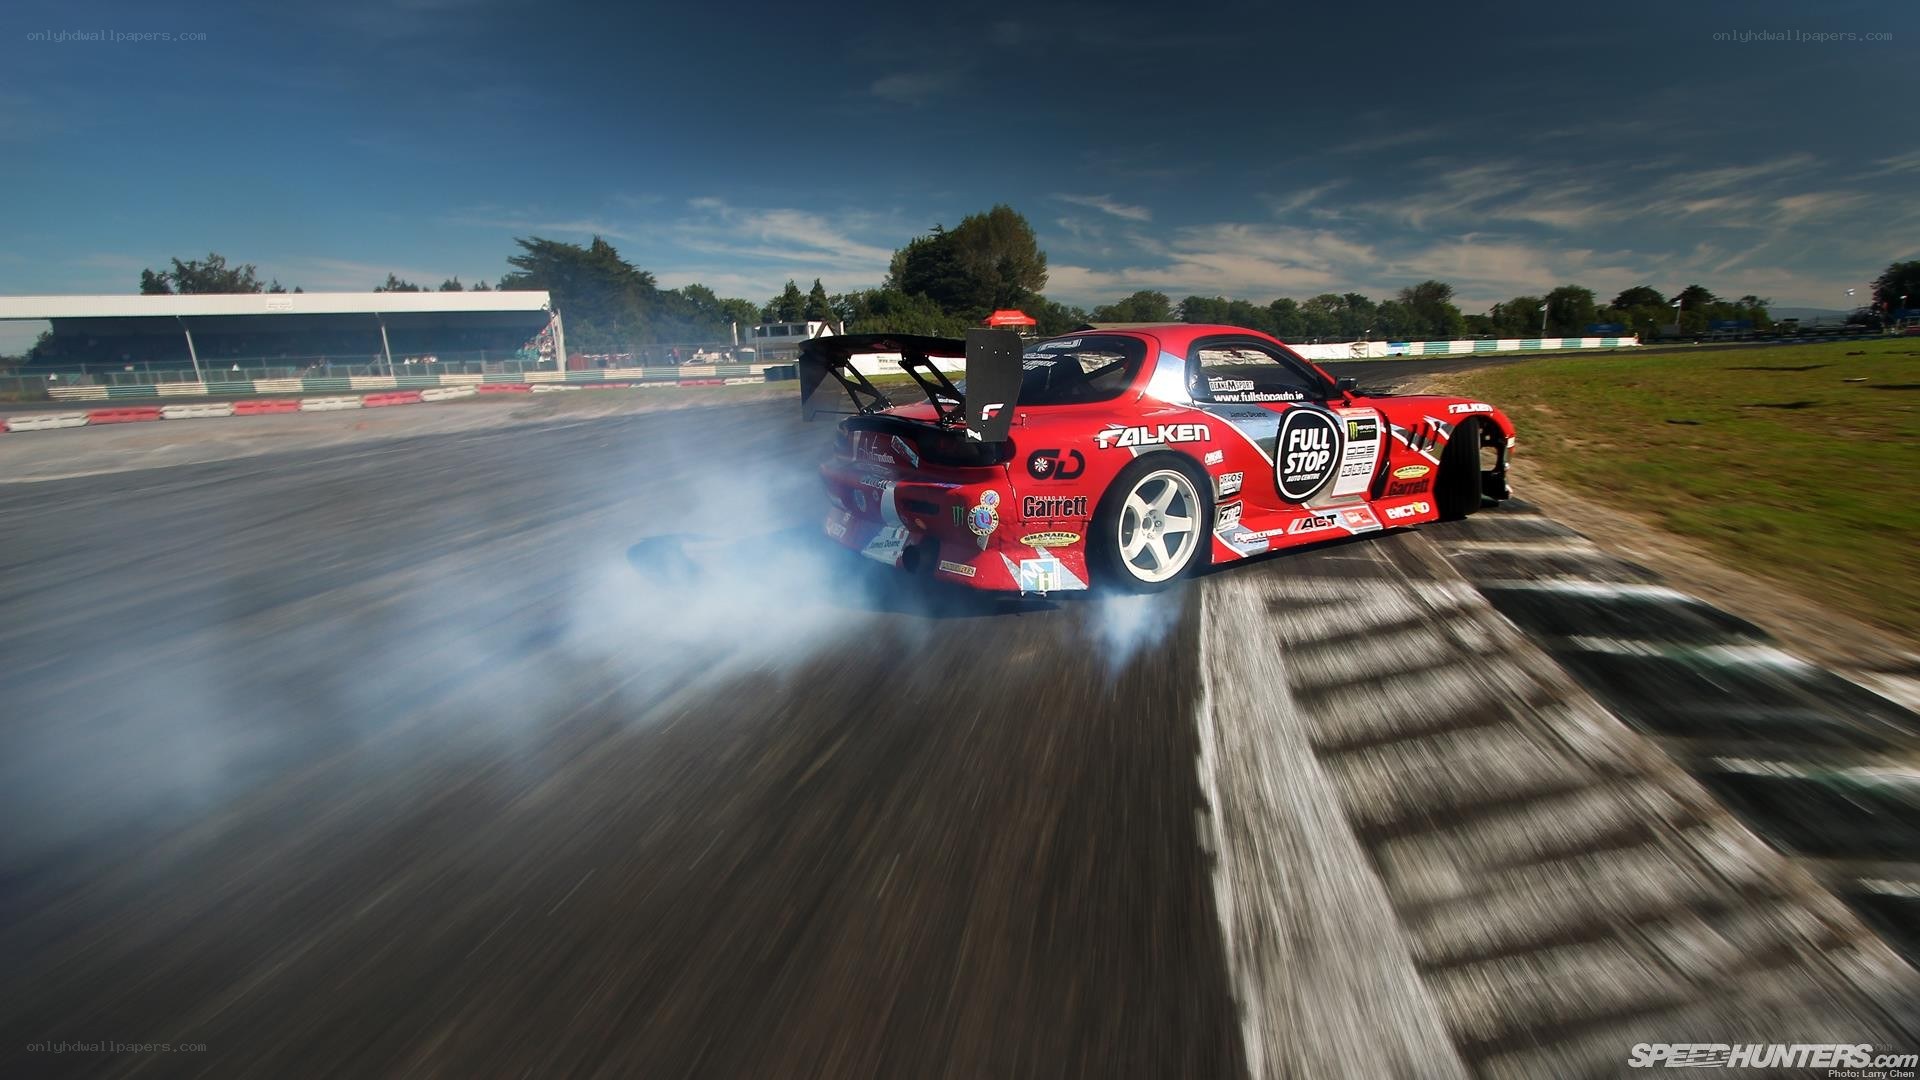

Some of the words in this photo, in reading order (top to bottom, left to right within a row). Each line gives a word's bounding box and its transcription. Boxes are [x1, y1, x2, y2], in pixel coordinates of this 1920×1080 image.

[1214, 392, 1304, 402] www.fullstopauto.ie
[1094, 424, 1211, 449] FALKEN
[1288, 427, 1331, 452] FULL
[1283, 450, 1331, 474] STOP.
[1390, 480, 1428, 496] Garrett
[1022, 495, 1088, 518] Garrett
[1301, 514, 1337, 530] ACT
